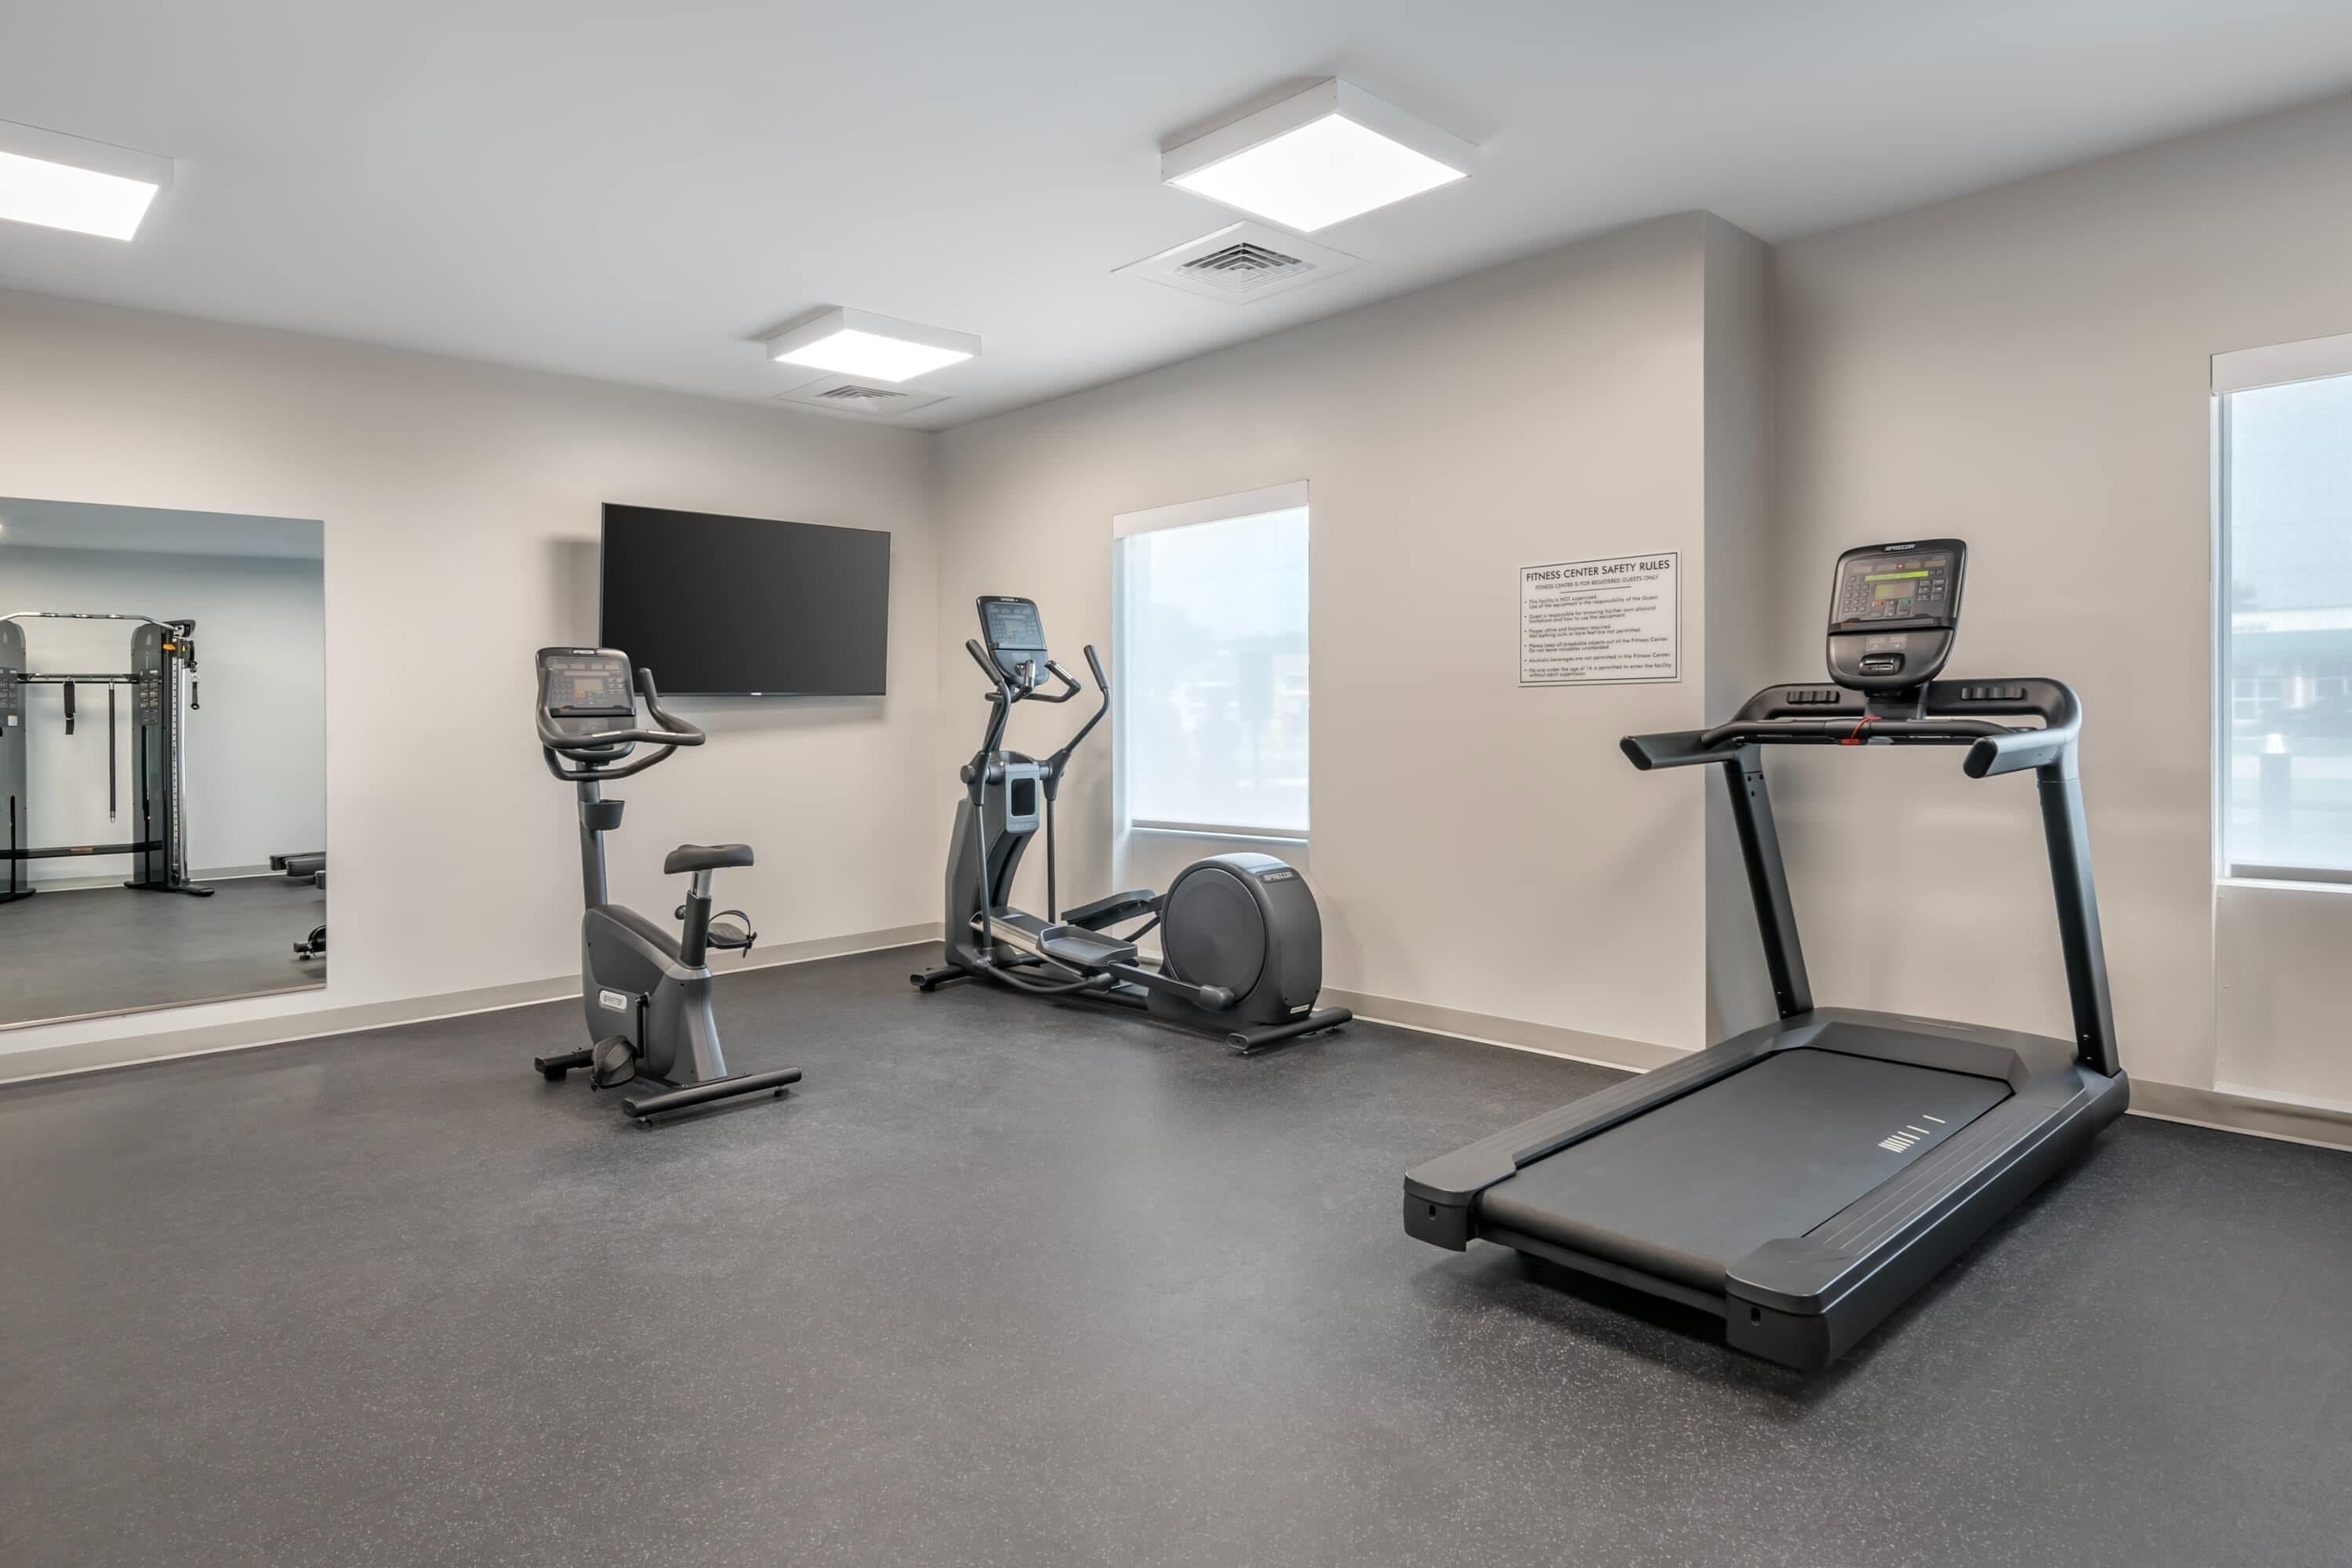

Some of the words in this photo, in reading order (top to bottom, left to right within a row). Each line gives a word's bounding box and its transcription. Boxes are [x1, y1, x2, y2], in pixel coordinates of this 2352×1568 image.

[1526, 571, 1561, 581] FITNESS
[1564, 567, 1599, 578] CENTER
[1602, 564, 1636, 575] SAFETY
[1640, 560, 1670, 571] RULES
